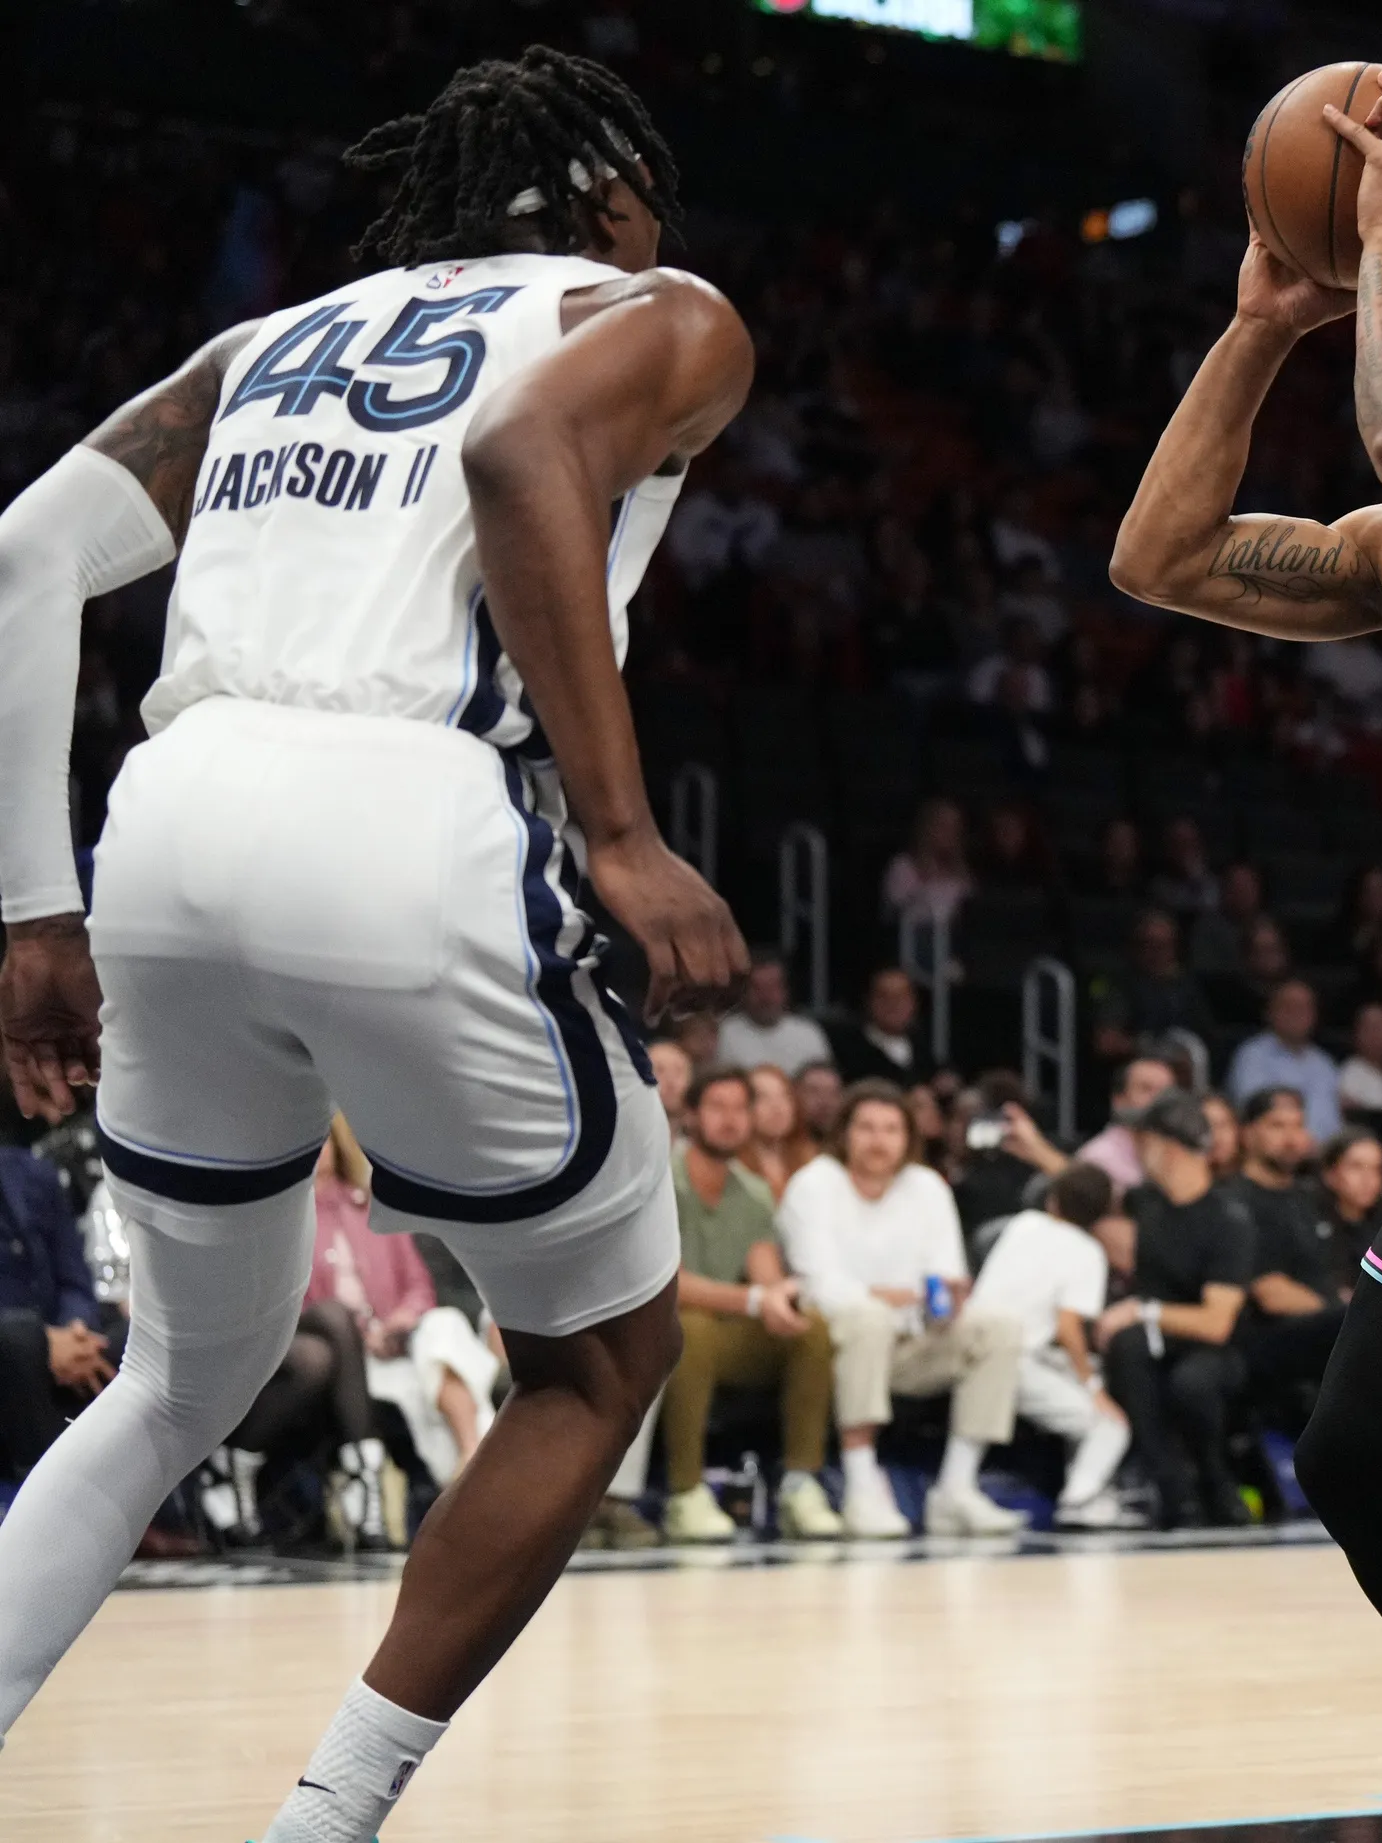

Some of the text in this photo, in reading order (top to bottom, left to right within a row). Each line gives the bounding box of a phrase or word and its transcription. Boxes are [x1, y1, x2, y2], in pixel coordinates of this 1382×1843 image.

[217, 285, 527, 432] 45
[194, 442, 439, 517] JACKSON II
